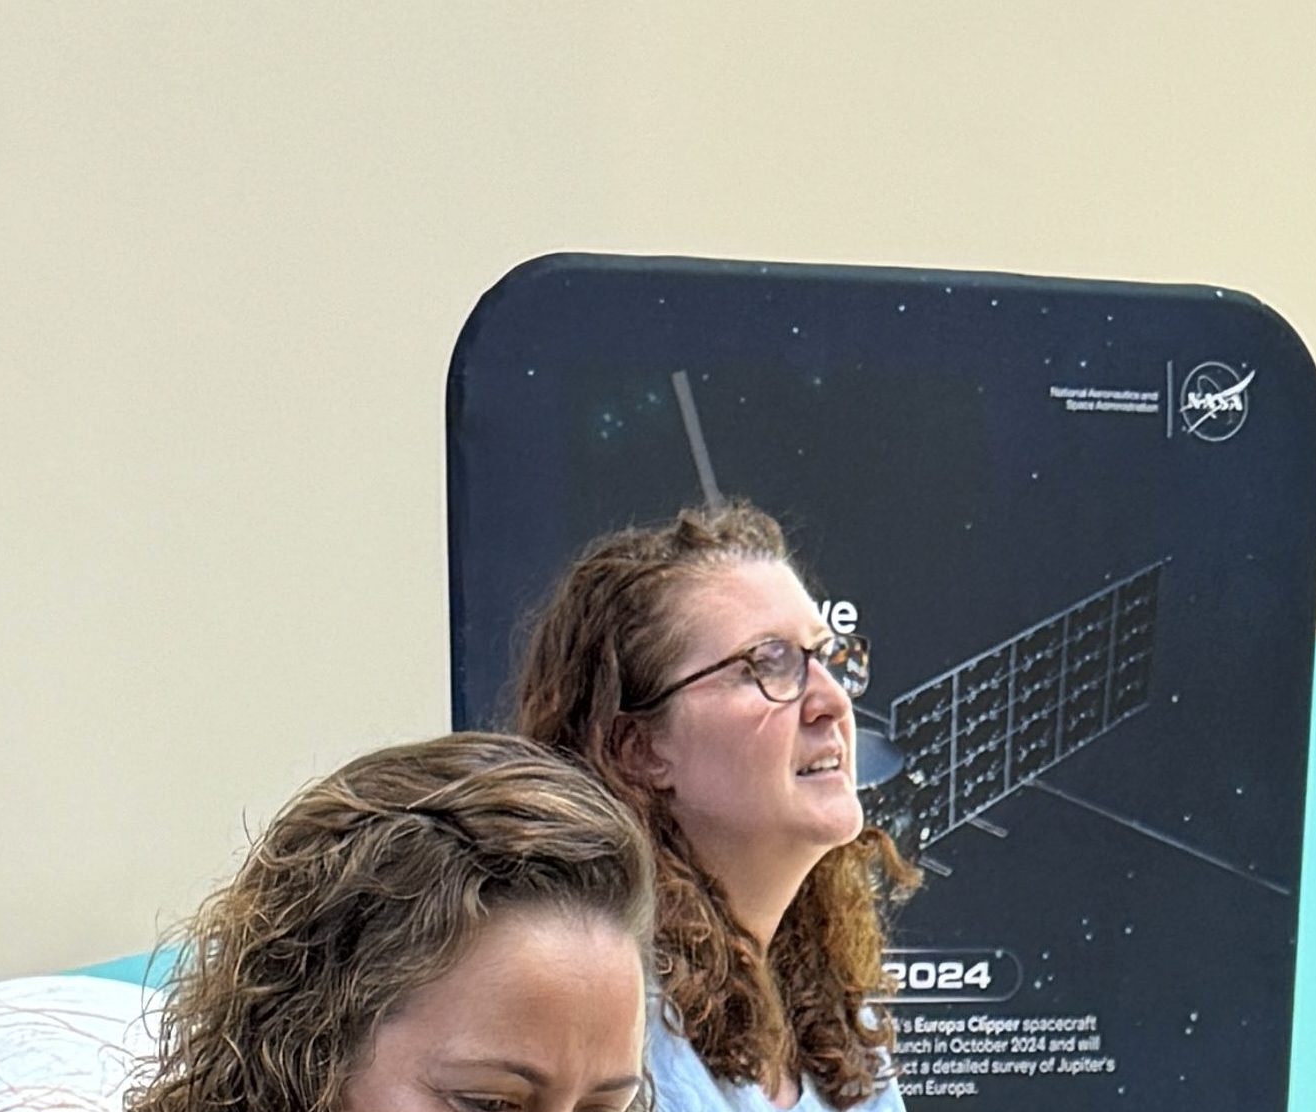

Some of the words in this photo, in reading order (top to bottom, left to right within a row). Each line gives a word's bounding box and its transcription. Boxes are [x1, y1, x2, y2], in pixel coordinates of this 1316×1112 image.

[881, 961, 991, 989] 2024
[914, 1016, 965, 1035] Europa
[968, 1015, 1020, 1035] Clipper
[1023, 1014, 1097, 1034] spacecraft
[934, 1037, 948, 1053] in
[950, 1037, 1008, 1053] October
[1011, 1036, 1046, 1052] 2024
[1049, 1035, 1075, 1052] and
[1078, 1035, 1101, 1051] will
[920, 1061, 930, 1075] a
[932, 1059, 989, 1074] detailed
[992, 1061, 1037, 1077] survey
[1039, 1057, 1055, 1073] of
[1057, 1057, 1115, 1075] Jupiter's
[925, 1080, 979, 1098] Europa.
